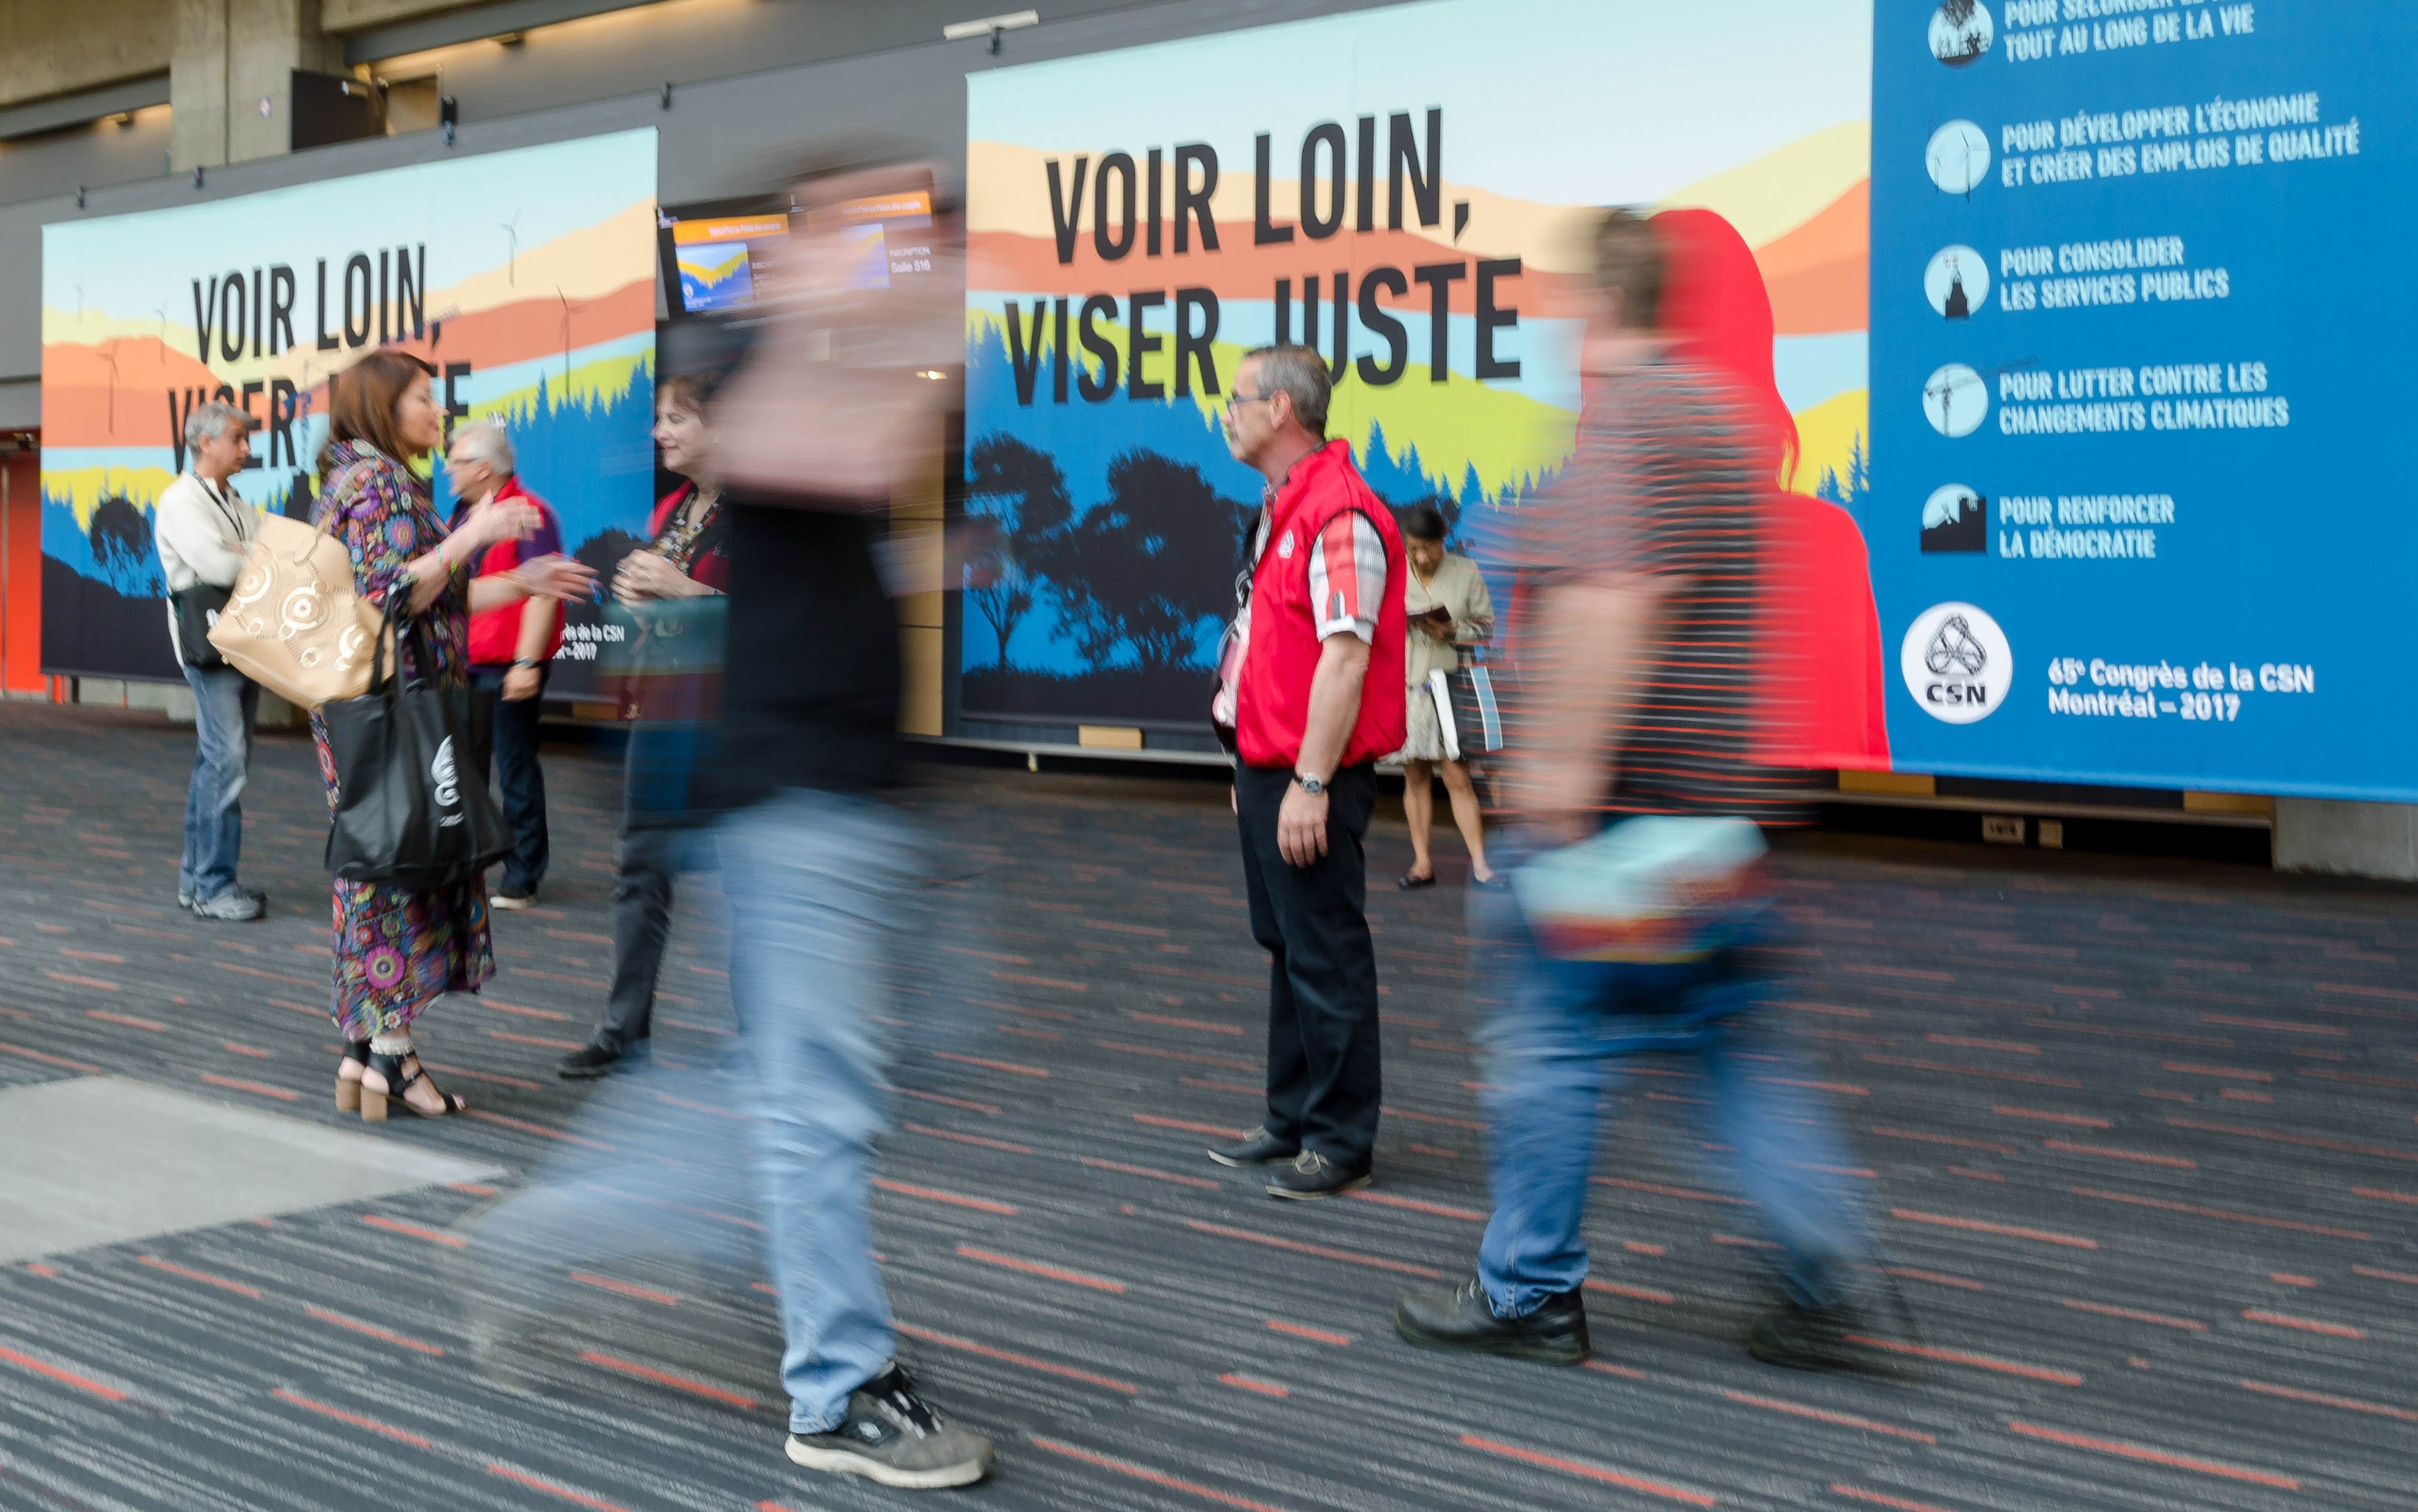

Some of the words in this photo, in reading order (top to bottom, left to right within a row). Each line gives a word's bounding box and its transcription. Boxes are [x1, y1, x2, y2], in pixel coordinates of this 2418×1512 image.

[2004, 0, 2057, 29] POUR
[2004, 28, 2055, 63] TOUT
[2059, 23, 2088, 55] AU
[2093, 14, 2147, 51] LONG
[2153, 12, 2180, 44] DE
[2186, 8, 2214, 40] LA
[2219, 3, 2254, 35] VIE
[2002, 120, 2055, 153] POUR
[2060, 107, 2190, 148] DÉVELOPPER
[2195, 93, 2318, 134] L'ÉCONOMIE
[2001, 157, 2026, 187] ET
[2030, 146, 2092, 184] CRÉER
[2098, 144, 2137, 177] DES
[2141, 136, 2230, 174] EMPLOIS
[2235, 134, 2264, 166] DE
[2268, 117, 2360, 162] QUALITÉ
[1046, 143, 1220, 264] VOIR
[1254, 105, 1469, 246] LOIN,
[2001, 245, 2054, 278] POUR
[2058, 235, 2184, 274] CONSOLIDER
[193, 266, 297, 364] VOIR
[317, 243, 441, 350] LOIN,
[2000, 281, 2036, 311] LES
[2040, 274, 2135, 309] SERVICES
[2141, 267, 2230, 302] PUBLICS
[1005, 286, 1222, 406] VISER
[1999, 370, 2053, 402] POUR
[2058, 367, 2135, 399] LUTTER
[2139, 363, 2222, 396] CONTRE
[2227, 361, 2268, 393] LES
[168, 378, 297, 474] VER
[1999, 401, 2146, 435] CHANGEMENTS
[2150, 396, 2289, 431] CLIMATIQUES
[1999, 495, 2053, 525] POUR
[2058, 493, 2175, 525] RENFORCER
[1999, 529, 2026, 559] LA
[2029, 523, 2156, 559] DÉMOCRATIE
[572, 641, 597, 661] 2017
[602, 624, 625, 642] CSN
[1926, 683, 1988, 707] CSN
[2089, 657, 2188, 692] Congrès
[2192, 661, 2225, 690] de
[2229, 662, 2254, 691] la
[2259, 663, 2315, 693] CSN
[2048, 686, 2157, 718] Montréal
[2180, 691, 2241, 722] 2017
